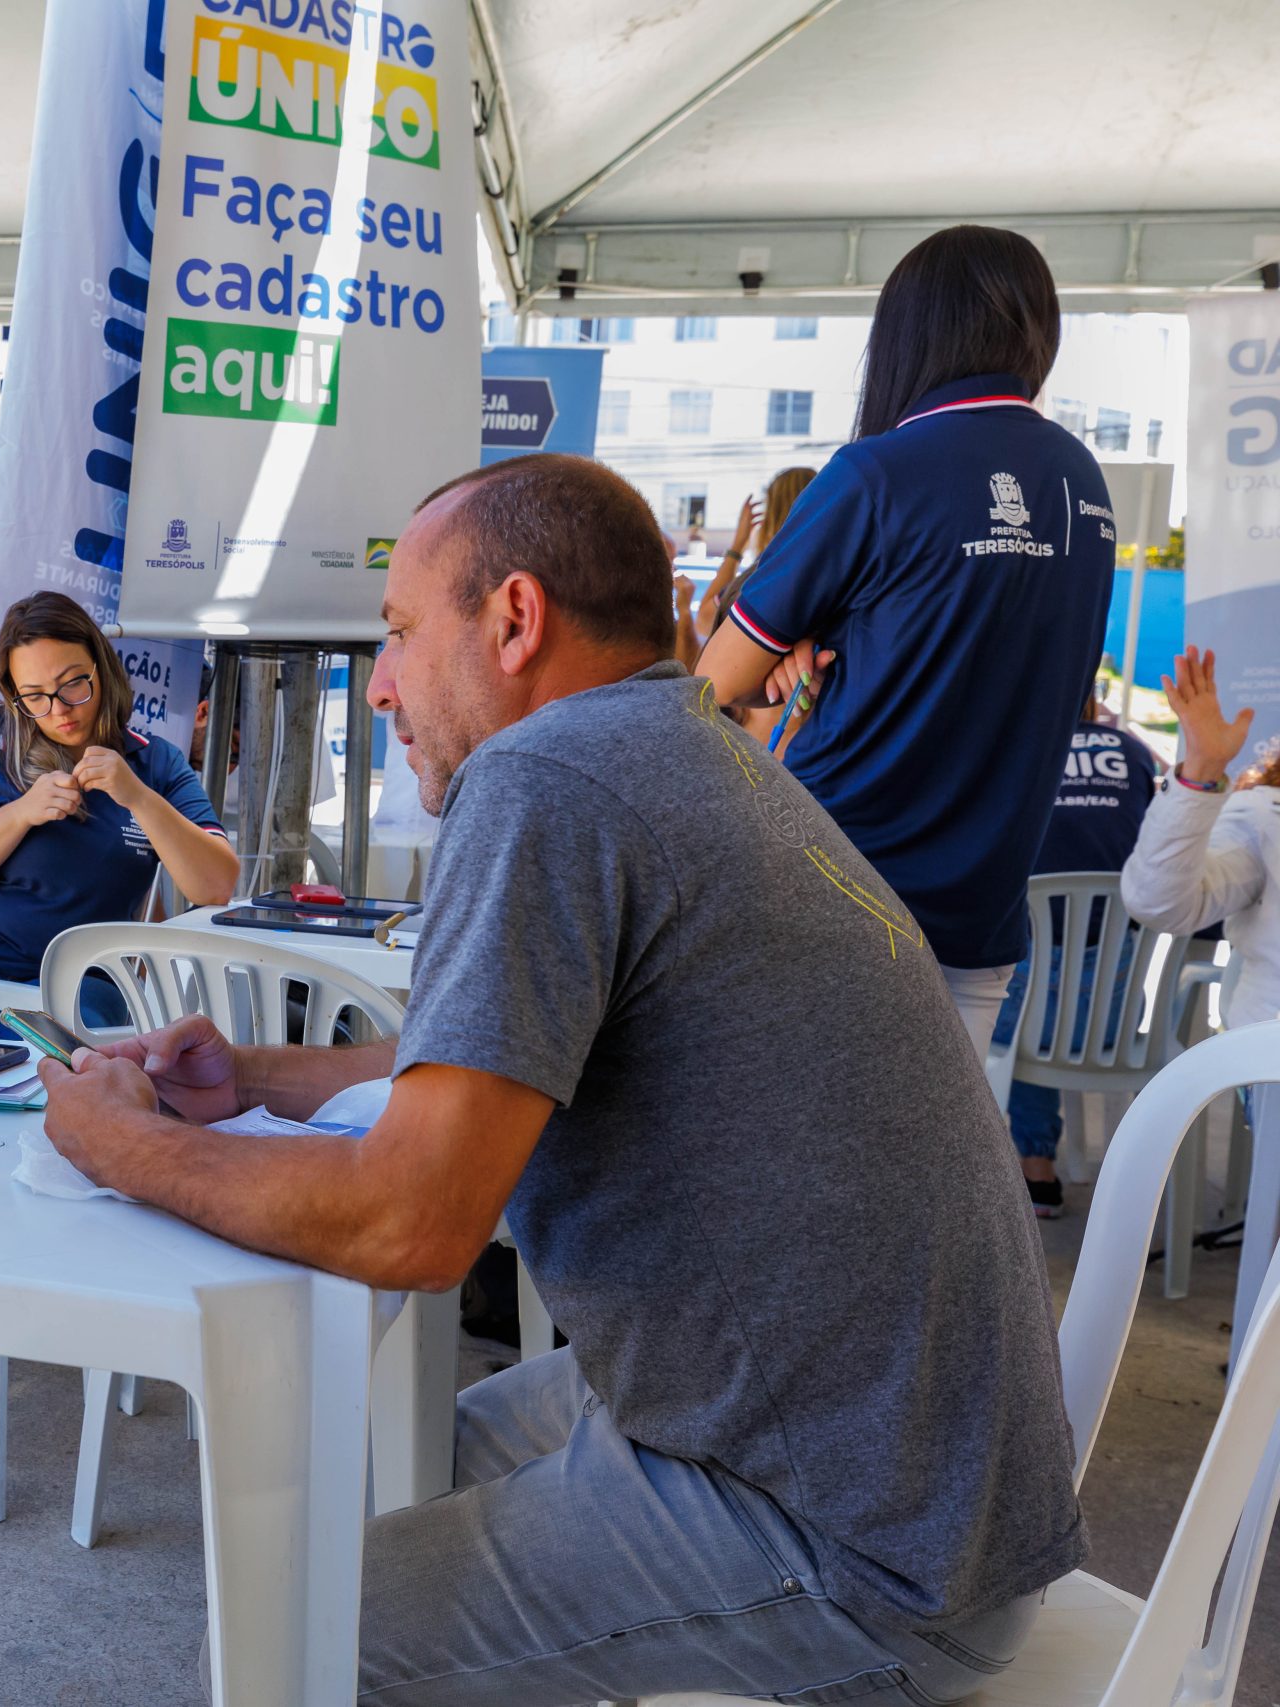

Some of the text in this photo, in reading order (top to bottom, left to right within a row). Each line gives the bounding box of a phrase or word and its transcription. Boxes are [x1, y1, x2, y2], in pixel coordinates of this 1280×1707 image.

[196, 26, 435, 160] ÚNICO
[182, 155, 443, 255] Faça seu
[176, 254, 444, 334] cadastro
[169, 338, 334, 412] aqui!
[223, 537, 287, 548] Desenvolvimento
[311, 550, 345, 559] MINISTÉRIO
[145, 559, 206, 570] TERESÓPOLIS
[320, 559, 354, 569] CIDADANIA
[1070, 733, 1122, 749] EAD
